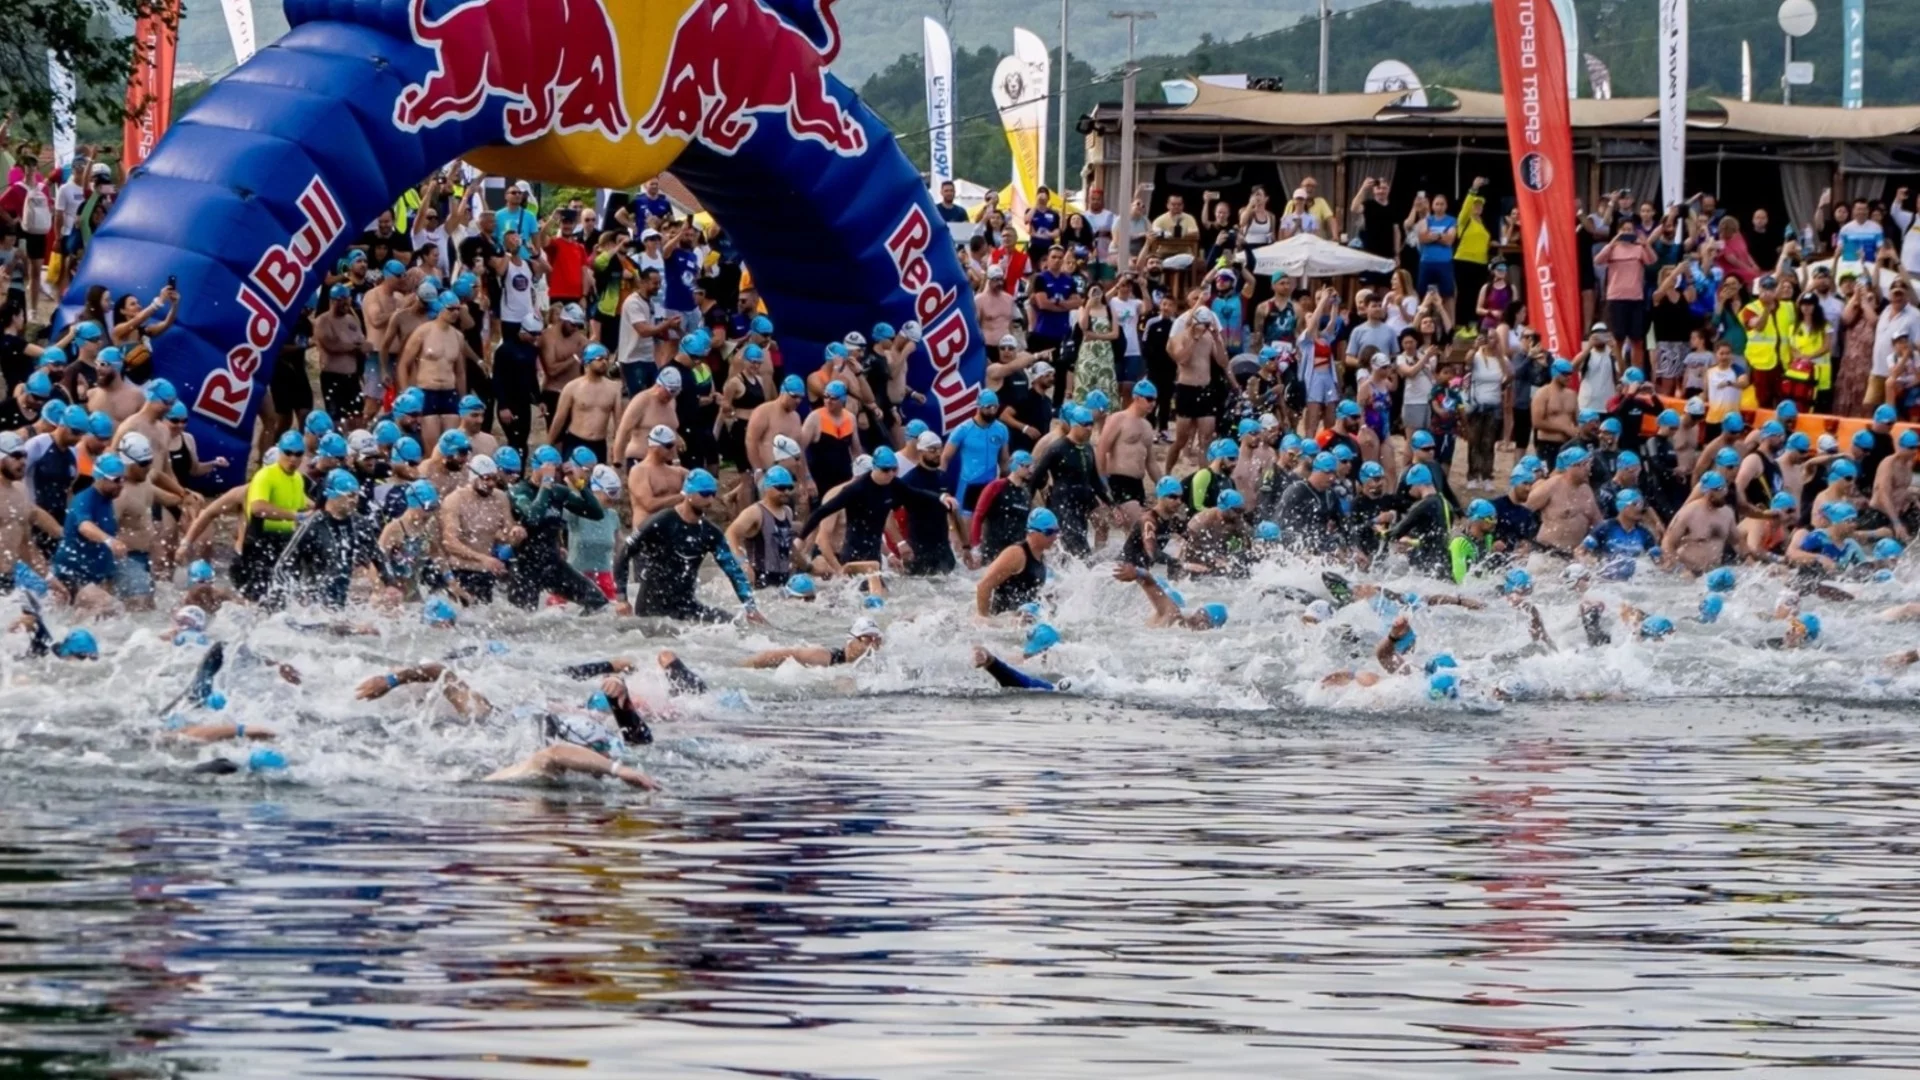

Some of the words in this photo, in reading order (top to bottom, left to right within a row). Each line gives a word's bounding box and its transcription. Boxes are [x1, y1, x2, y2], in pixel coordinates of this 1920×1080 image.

[193, 283, 280, 427] Red
[249, 175, 346, 312] Bull
[885, 203, 958, 327] Red
[922, 309, 981, 435] Bull
